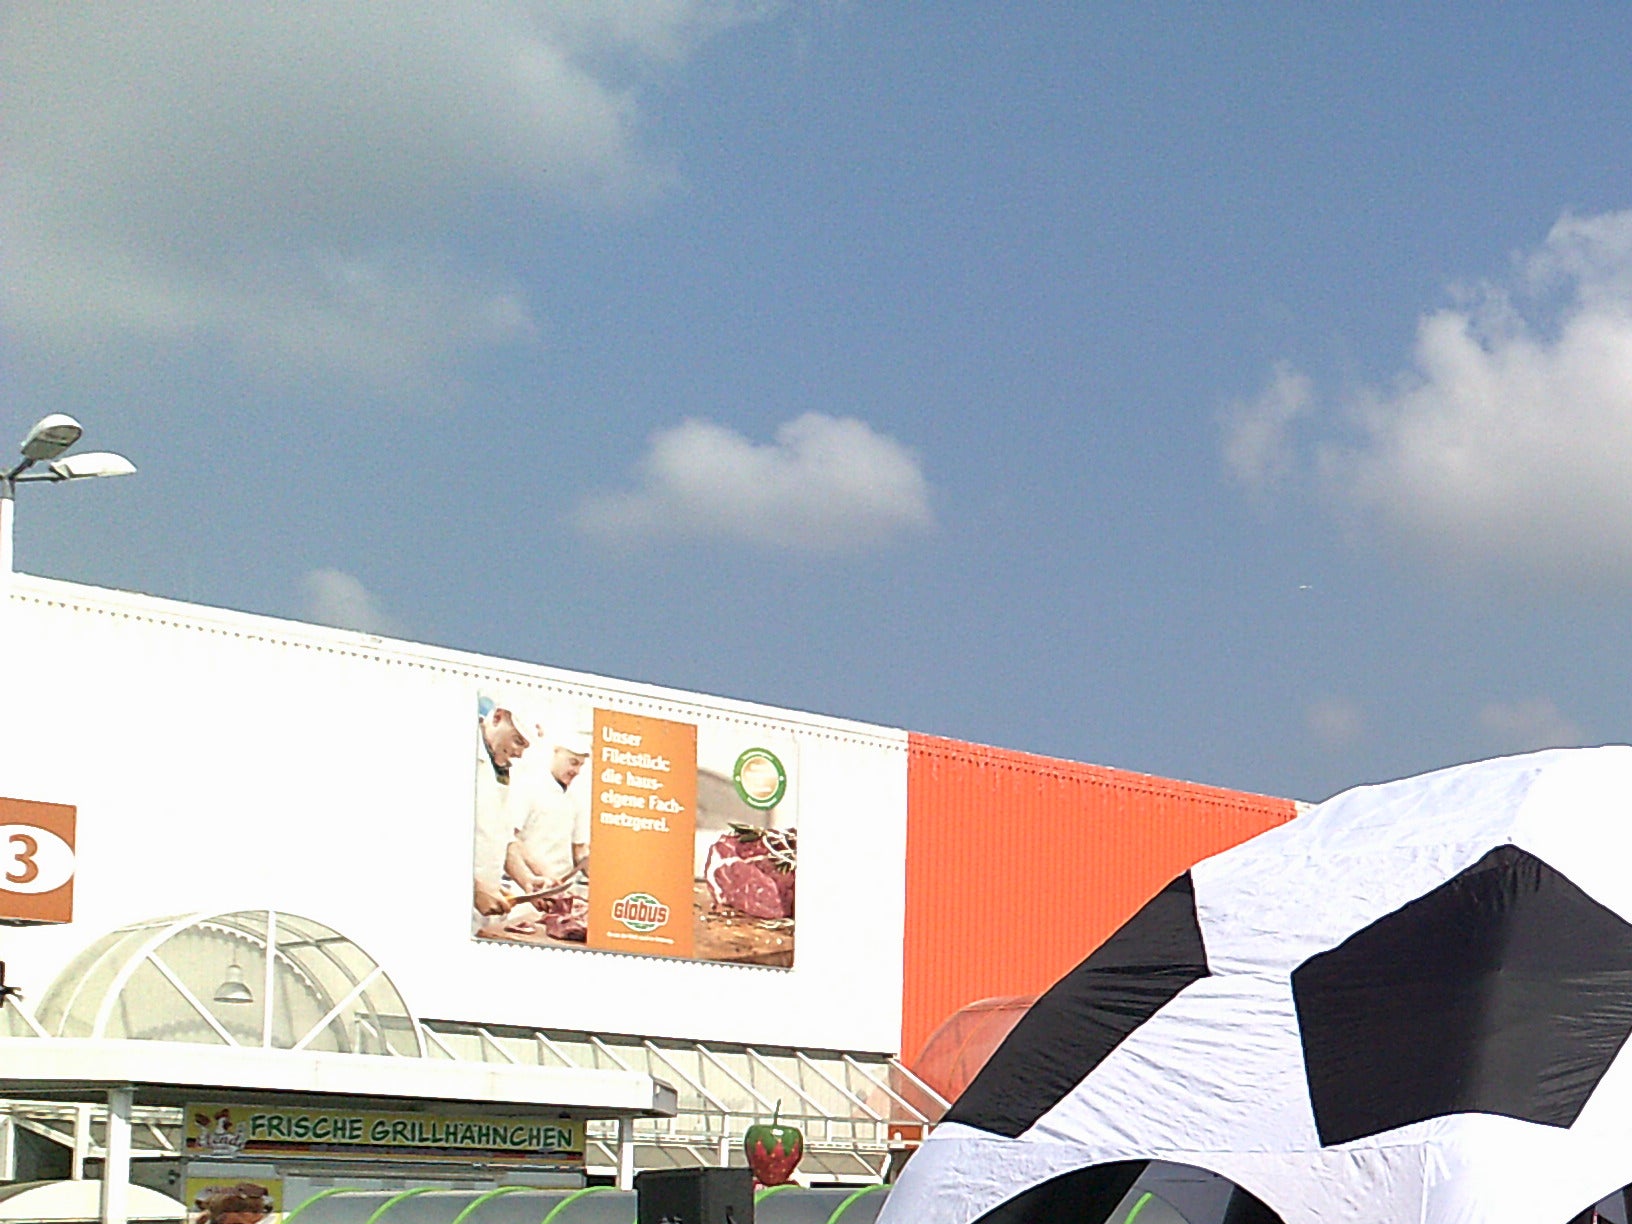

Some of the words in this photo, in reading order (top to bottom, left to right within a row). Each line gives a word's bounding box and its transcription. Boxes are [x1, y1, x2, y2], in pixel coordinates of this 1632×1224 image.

[602, 726, 641, 747] Unser
[601, 768, 623, 785] die
[626, 771, 664, 790] haus-
[600, 789, 645, 809] eigene
[648, 794, 685, 814] Fach-
[600, 812, 670, 832] metzgerei.
[5, 833, 39, 884] 3
[250, 1114, 363, 1140] FRISCHE
[370, 1119, 573, 1148] GRILLHÄHNCHEN
